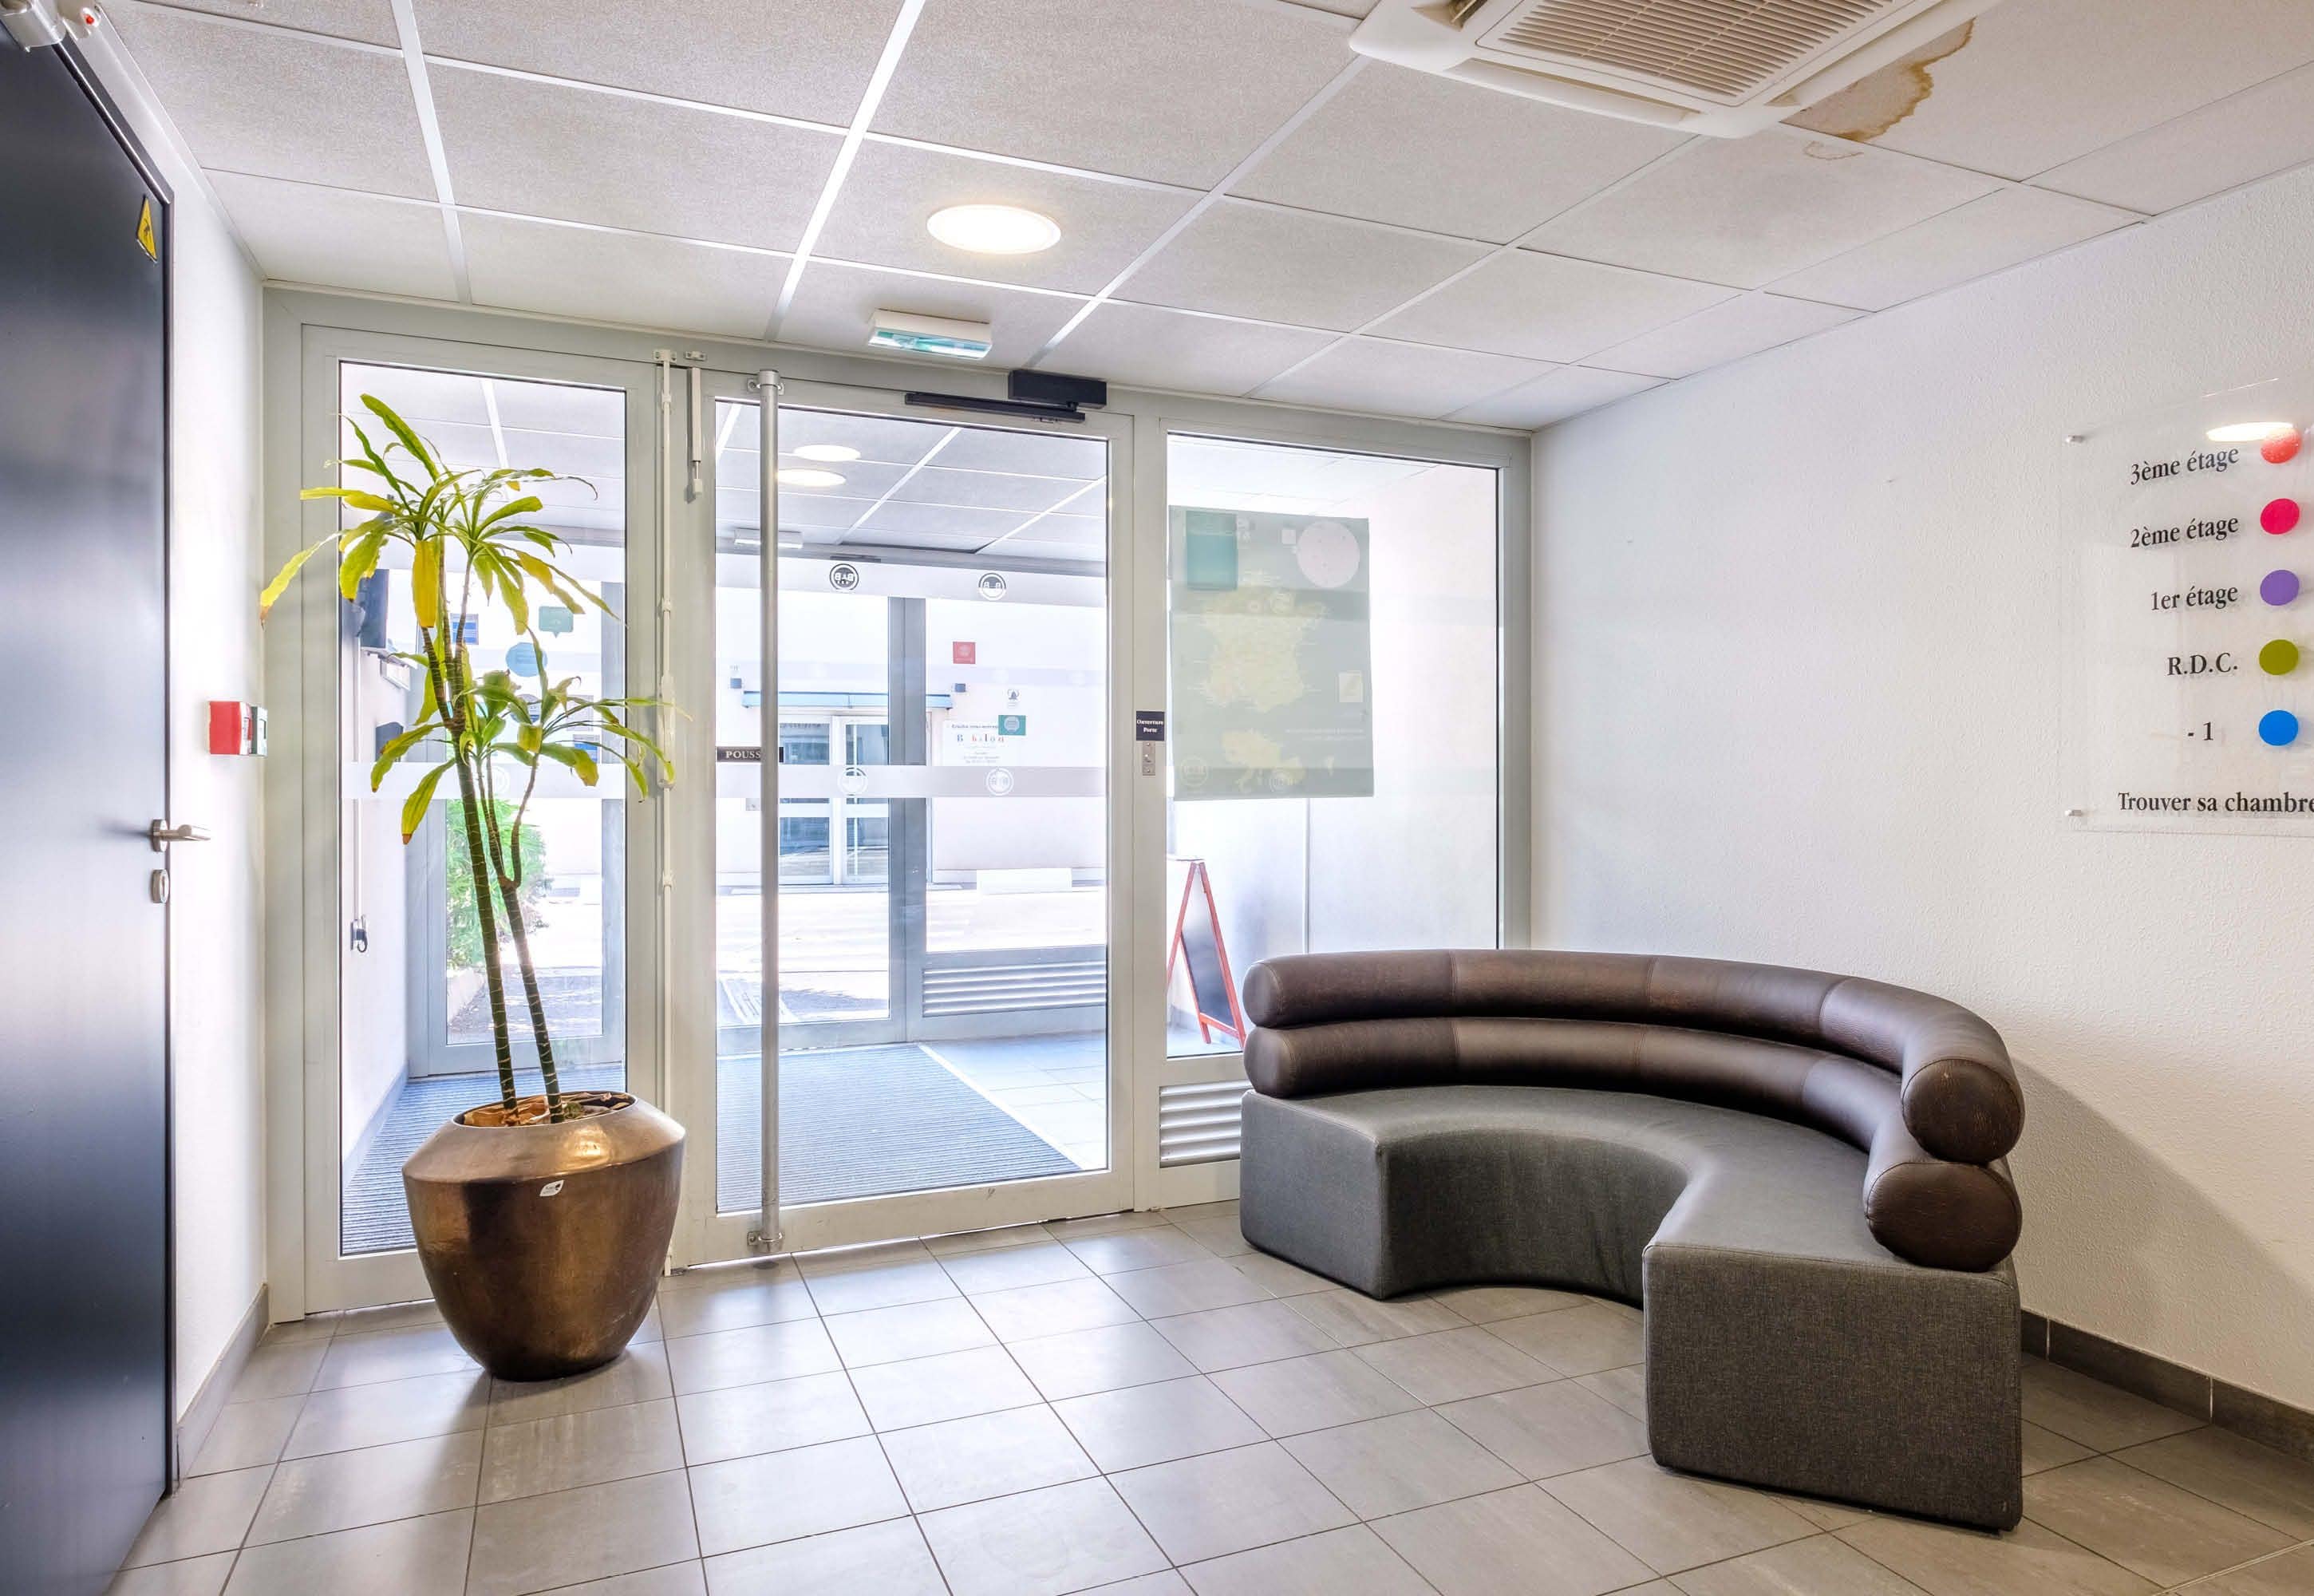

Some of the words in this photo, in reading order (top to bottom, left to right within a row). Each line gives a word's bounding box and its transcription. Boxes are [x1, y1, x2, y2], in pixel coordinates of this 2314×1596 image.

[2130, 460, 2181, 486] 3ème
[2186, 448, 2240, 474] étage
[2130, 525, 2181, 549] 2ème
[2186, 516, 2240, 542] étage
[2151, 591, 2181, 611] 1er
[2186, 584, 2239, 610] étage
[2167, 652, 2238, 677] R.D.C.
[725, 750, 761, 759] POUSS
[2118, 792, 2192, 812] Trouver
[2197, 796, 2219, 812] sa
